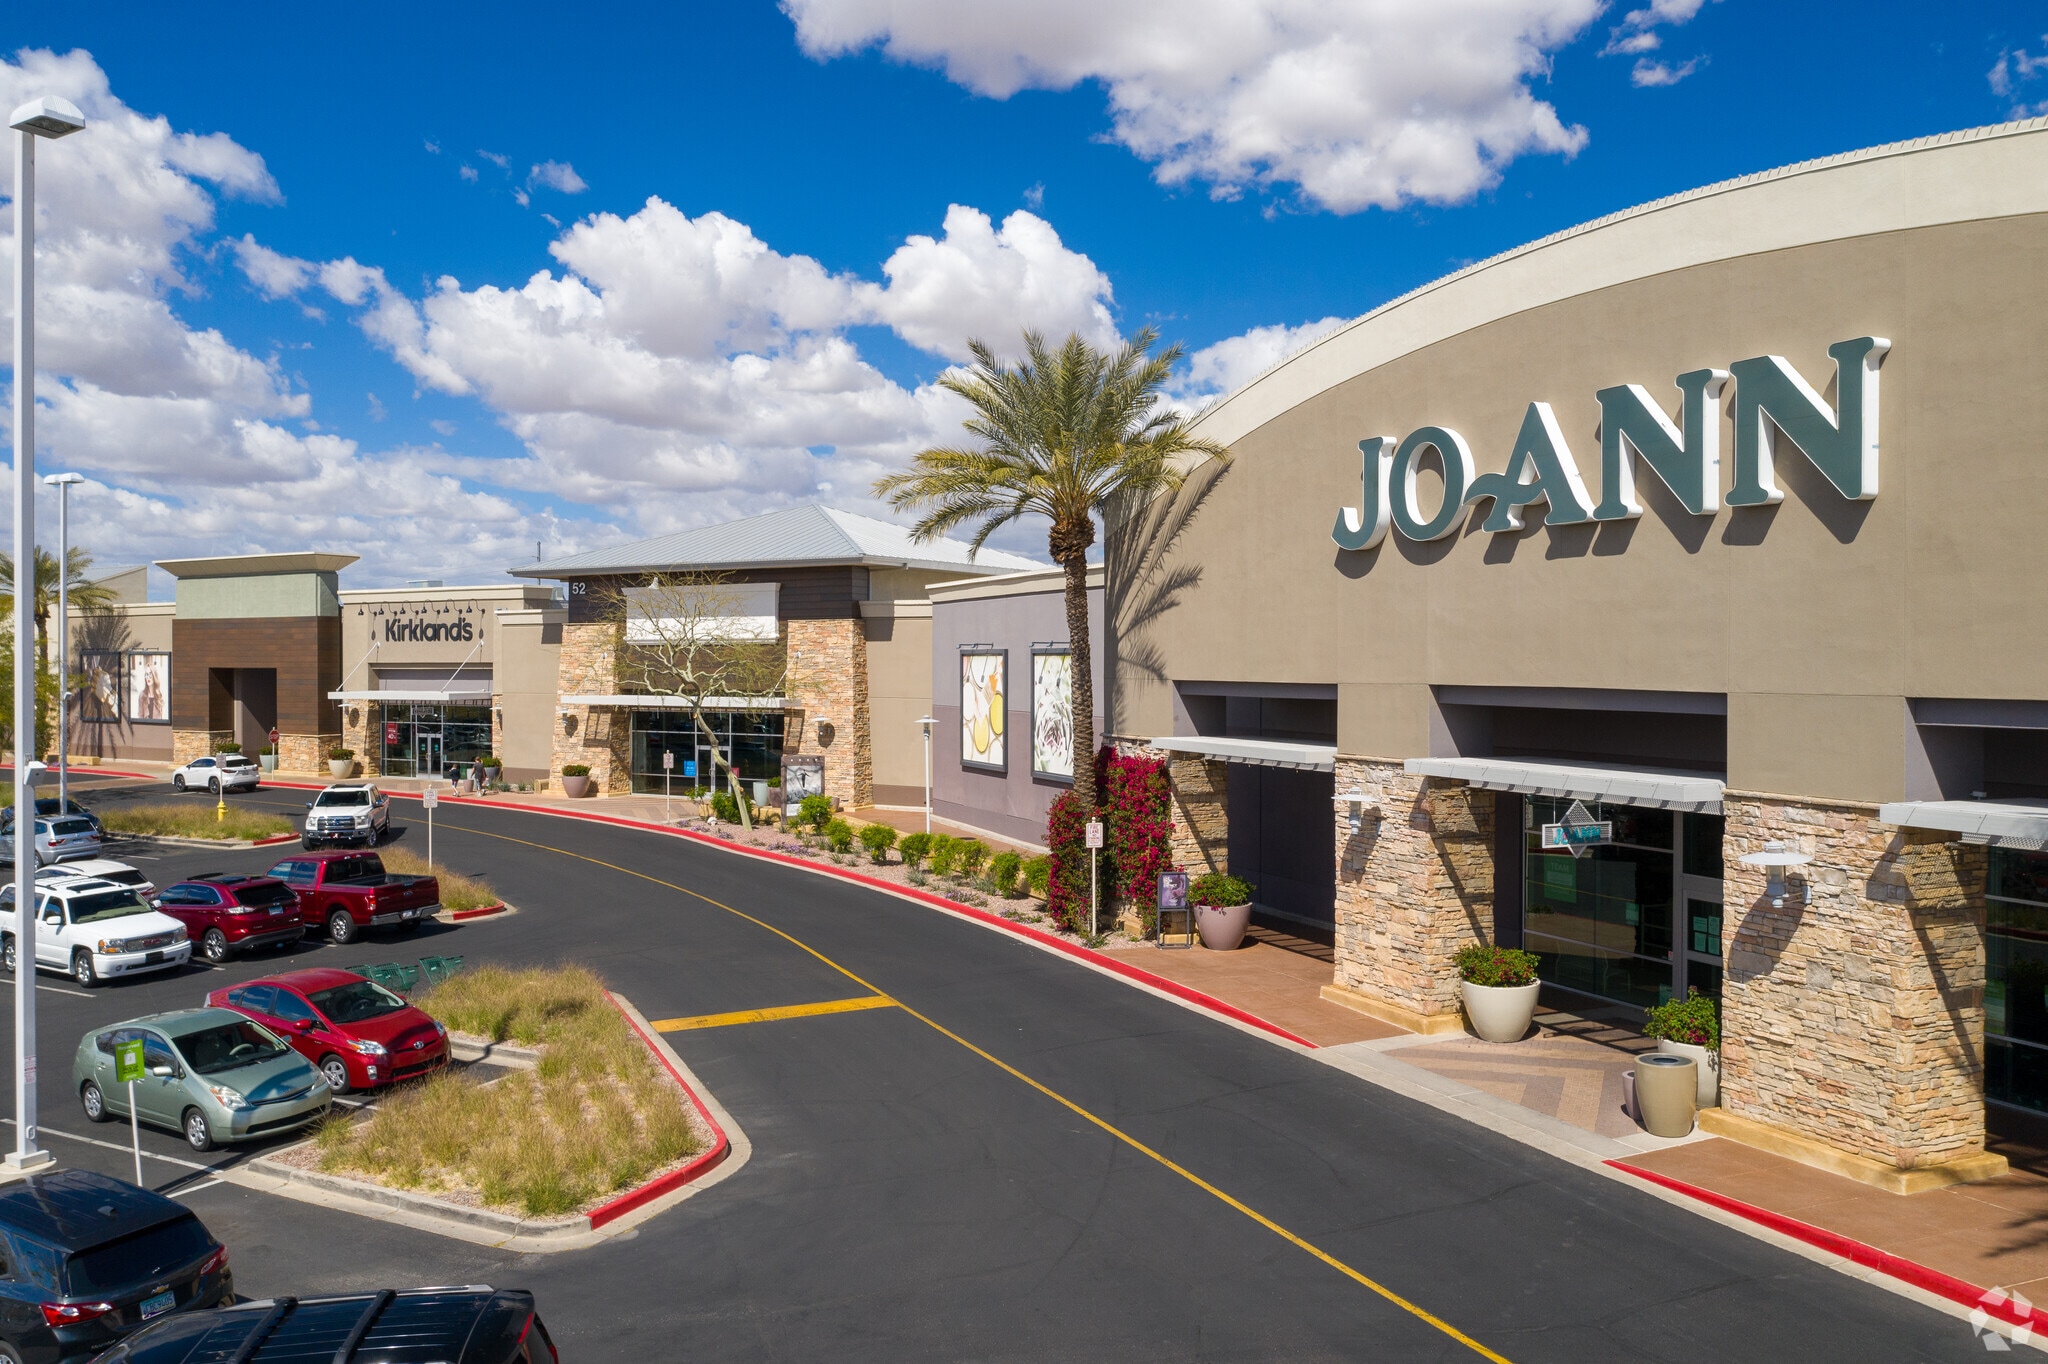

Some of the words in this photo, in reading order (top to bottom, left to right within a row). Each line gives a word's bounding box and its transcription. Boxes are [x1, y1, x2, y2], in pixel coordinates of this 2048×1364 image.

[1331, 336, 1891, 551] JOANN
[572, 582, 586, 594] 52
[385, 617, 473, 642] Kirkland's
